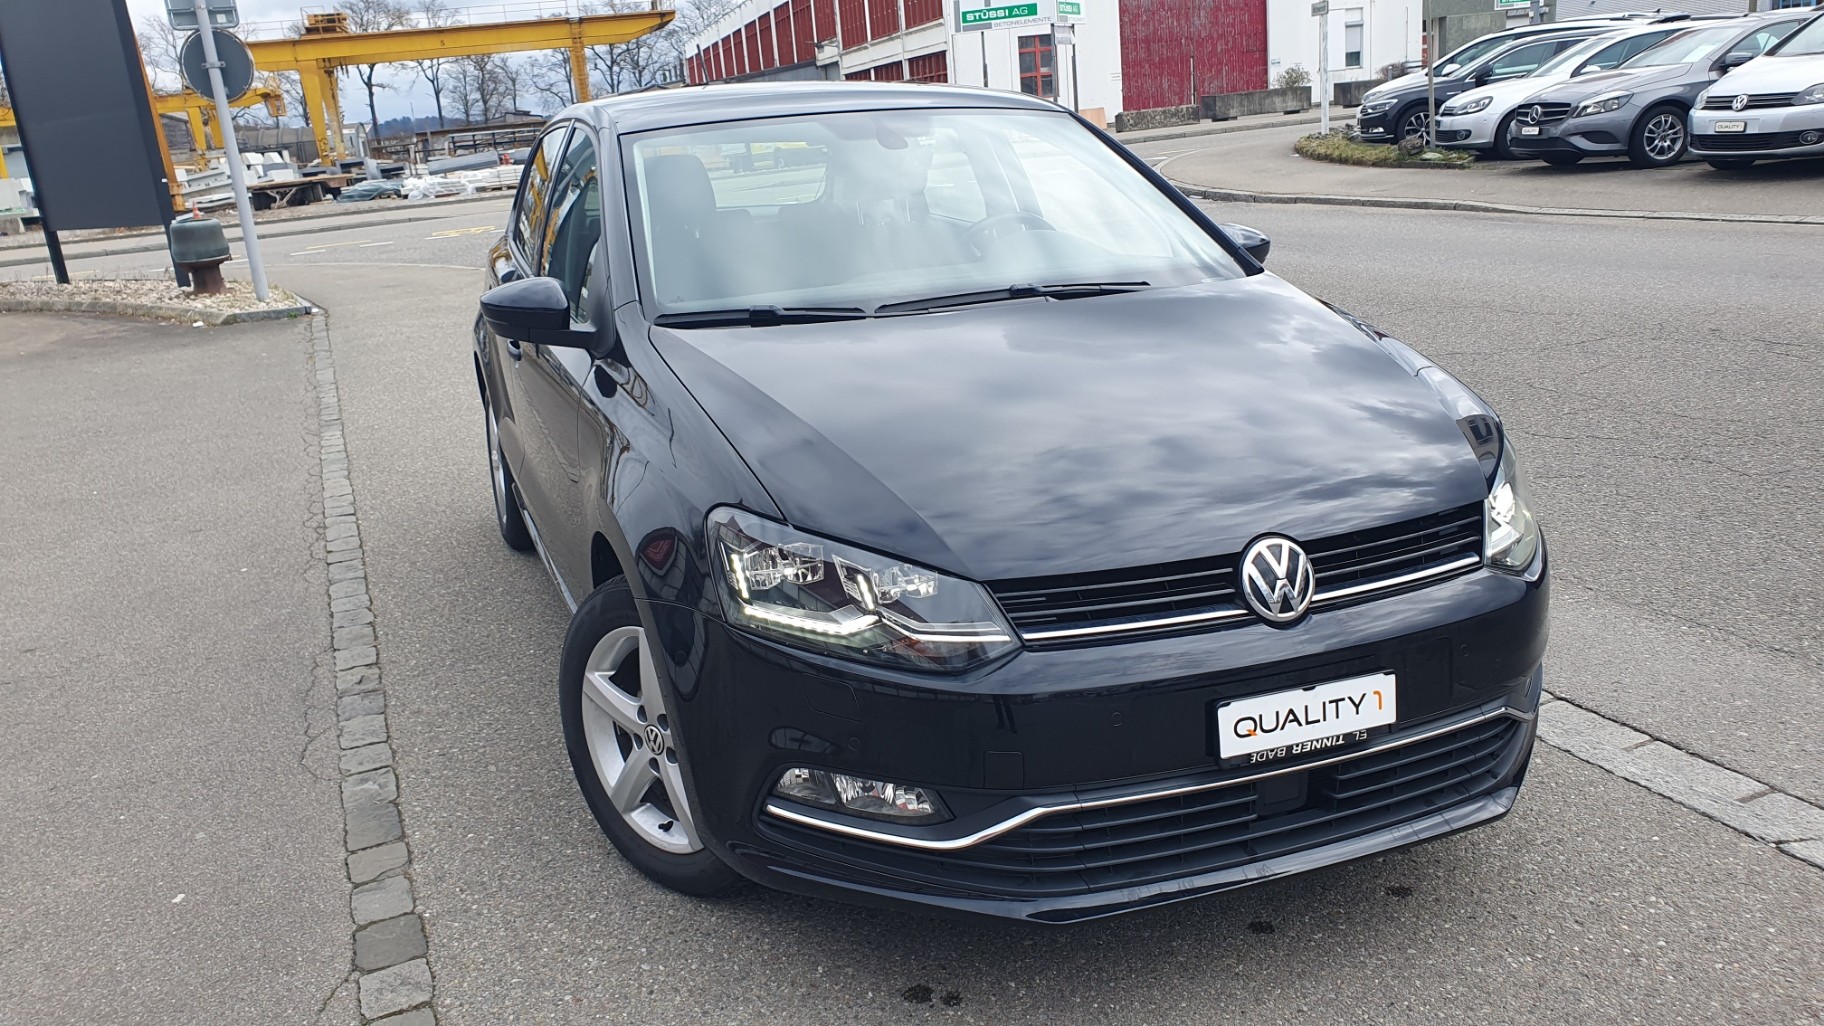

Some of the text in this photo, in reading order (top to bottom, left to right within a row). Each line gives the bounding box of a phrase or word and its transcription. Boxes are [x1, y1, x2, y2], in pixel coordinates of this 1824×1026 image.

[966, 7, 1028, 21] STÜSSI AG
[993, 16, 1052, 28] BETONELEMENTE
[1233, 690, 1383, 739] QUALITY 1
[1292, 735, 1345, 754] TINNER
[1250, 747, 1286, 763] BADE
